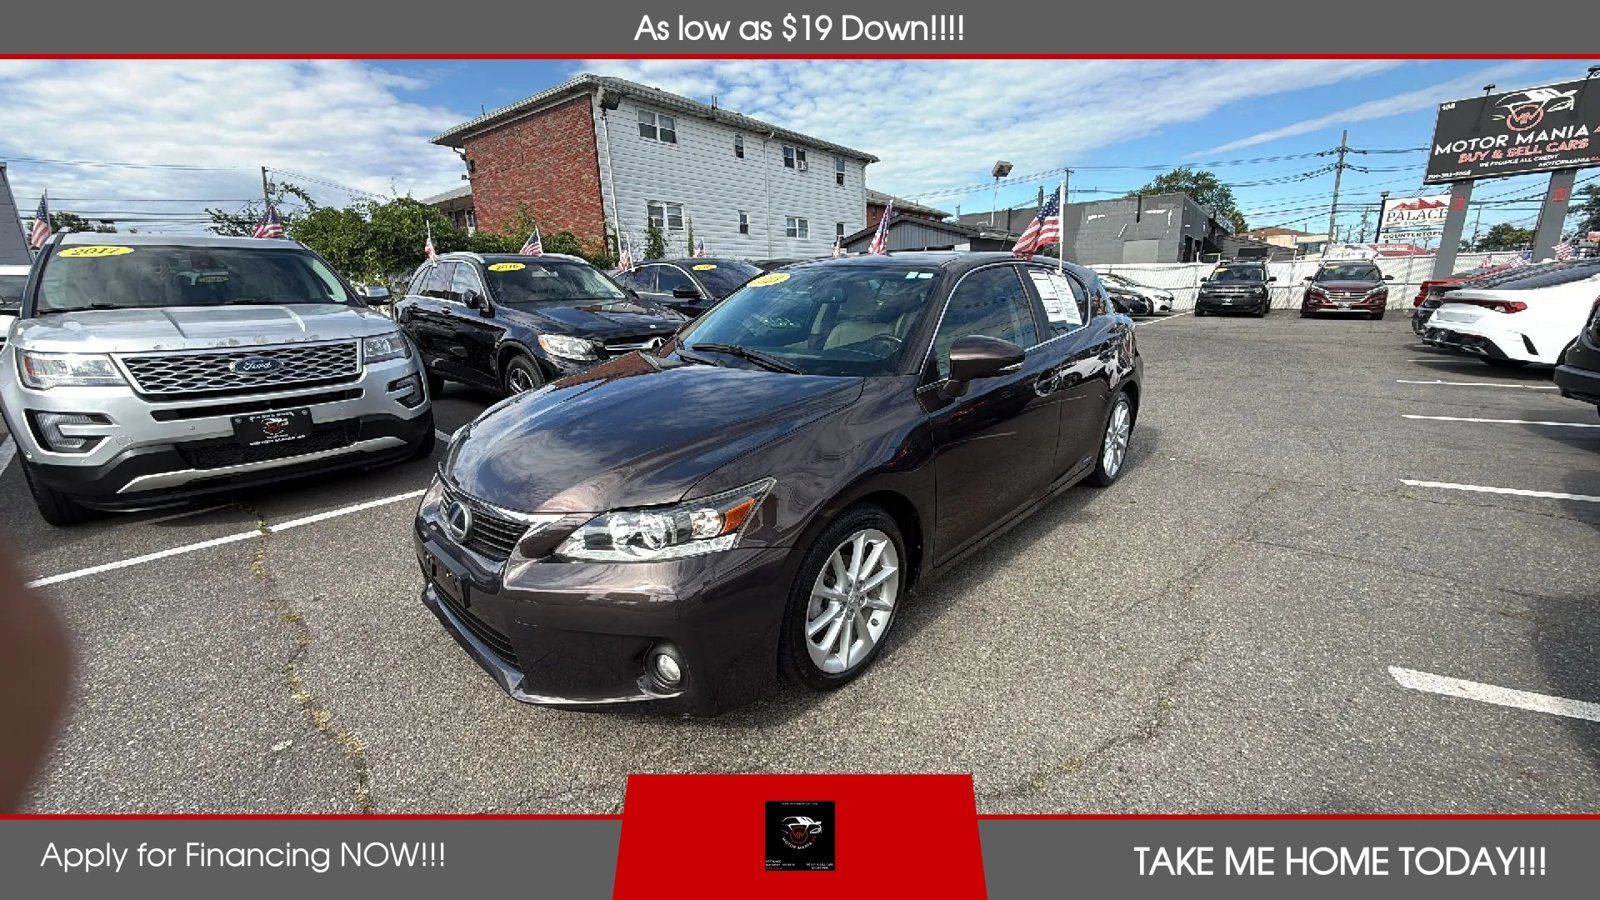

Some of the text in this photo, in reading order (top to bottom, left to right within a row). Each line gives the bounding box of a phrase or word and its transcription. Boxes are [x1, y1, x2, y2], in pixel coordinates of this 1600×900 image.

[1434, 123, 1589, 156] MOTOR MANIA
[1458, 138, 1589, 164] BUY & SELL CARS
[1386, 208, 1448, 222] PALACE
[1383, 231, 1441, 239] COUNTERTOPS
[243, 361, 273, 371] Ford
